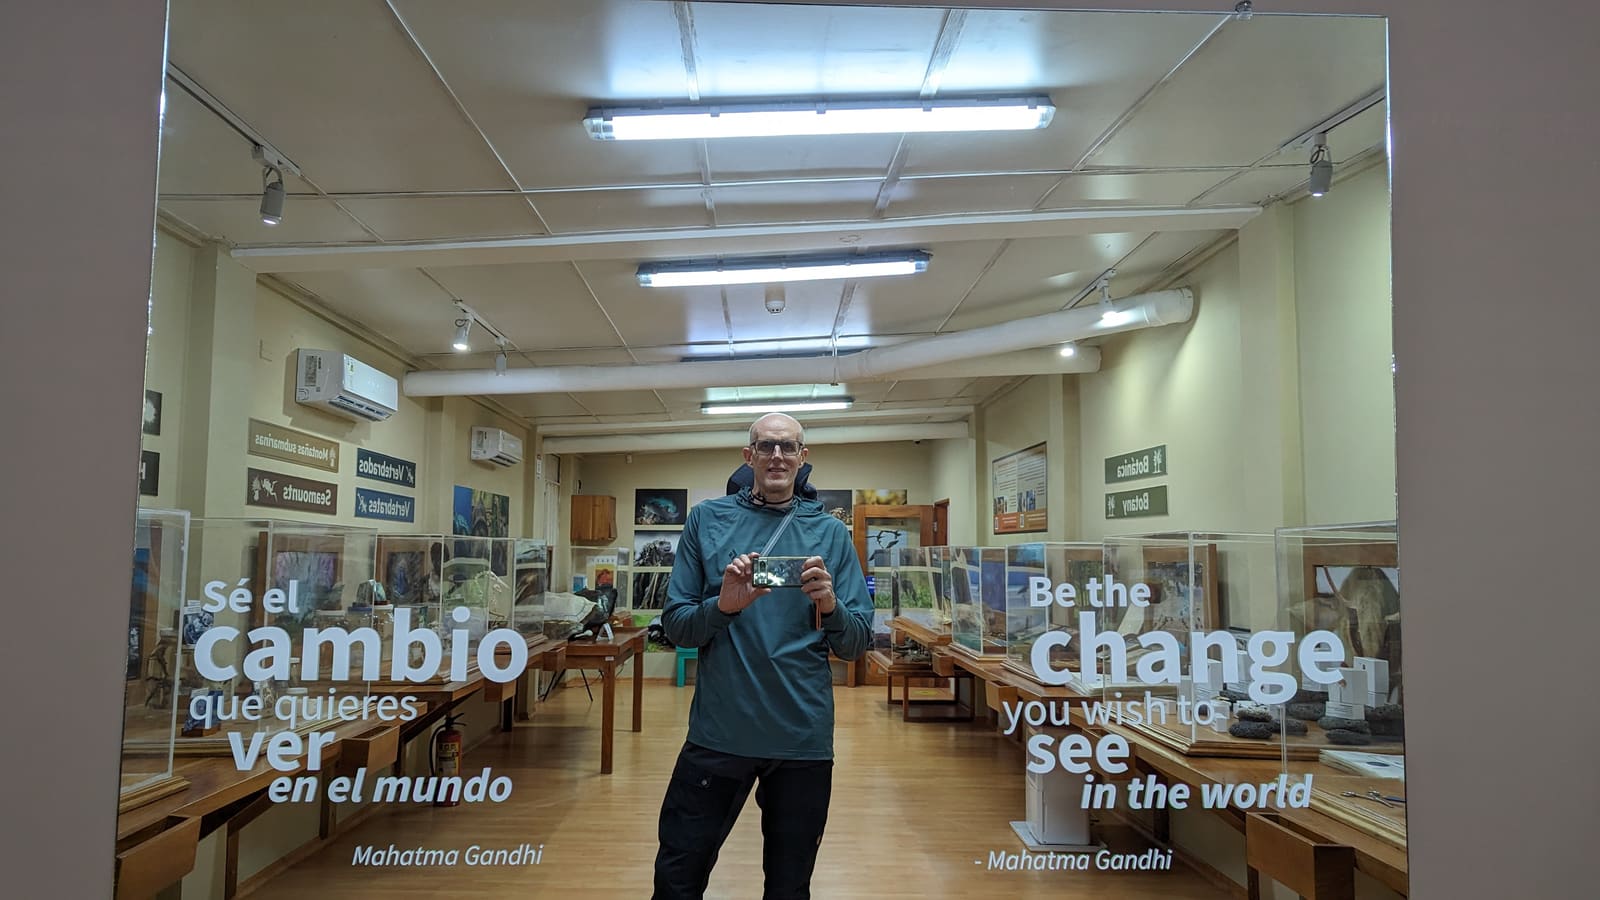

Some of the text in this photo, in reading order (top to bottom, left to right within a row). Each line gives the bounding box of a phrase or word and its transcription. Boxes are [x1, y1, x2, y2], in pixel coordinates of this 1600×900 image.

[203, 577, 300, 613] Sé el
[1029, 574, 1151, 608] Be the
[194, 606, 529, 683] cambio
[1030, 610, 1345, 705] change
[189, 687, 418, 729] que quieres
[1002, 692, 1215, 735] you wish to
[227, 731, 336, 772] ver
[1026, 733, 1130, 774] see
[268, 767, 513, 803] en el mundo
[1080, 773, 1314, 810] in the world
[351, 843, 545, 866] Mahatma Gandhi
[987, 849, 1090, 871] Mahatma
[1095, 848, 1174, 871] Gandhi
